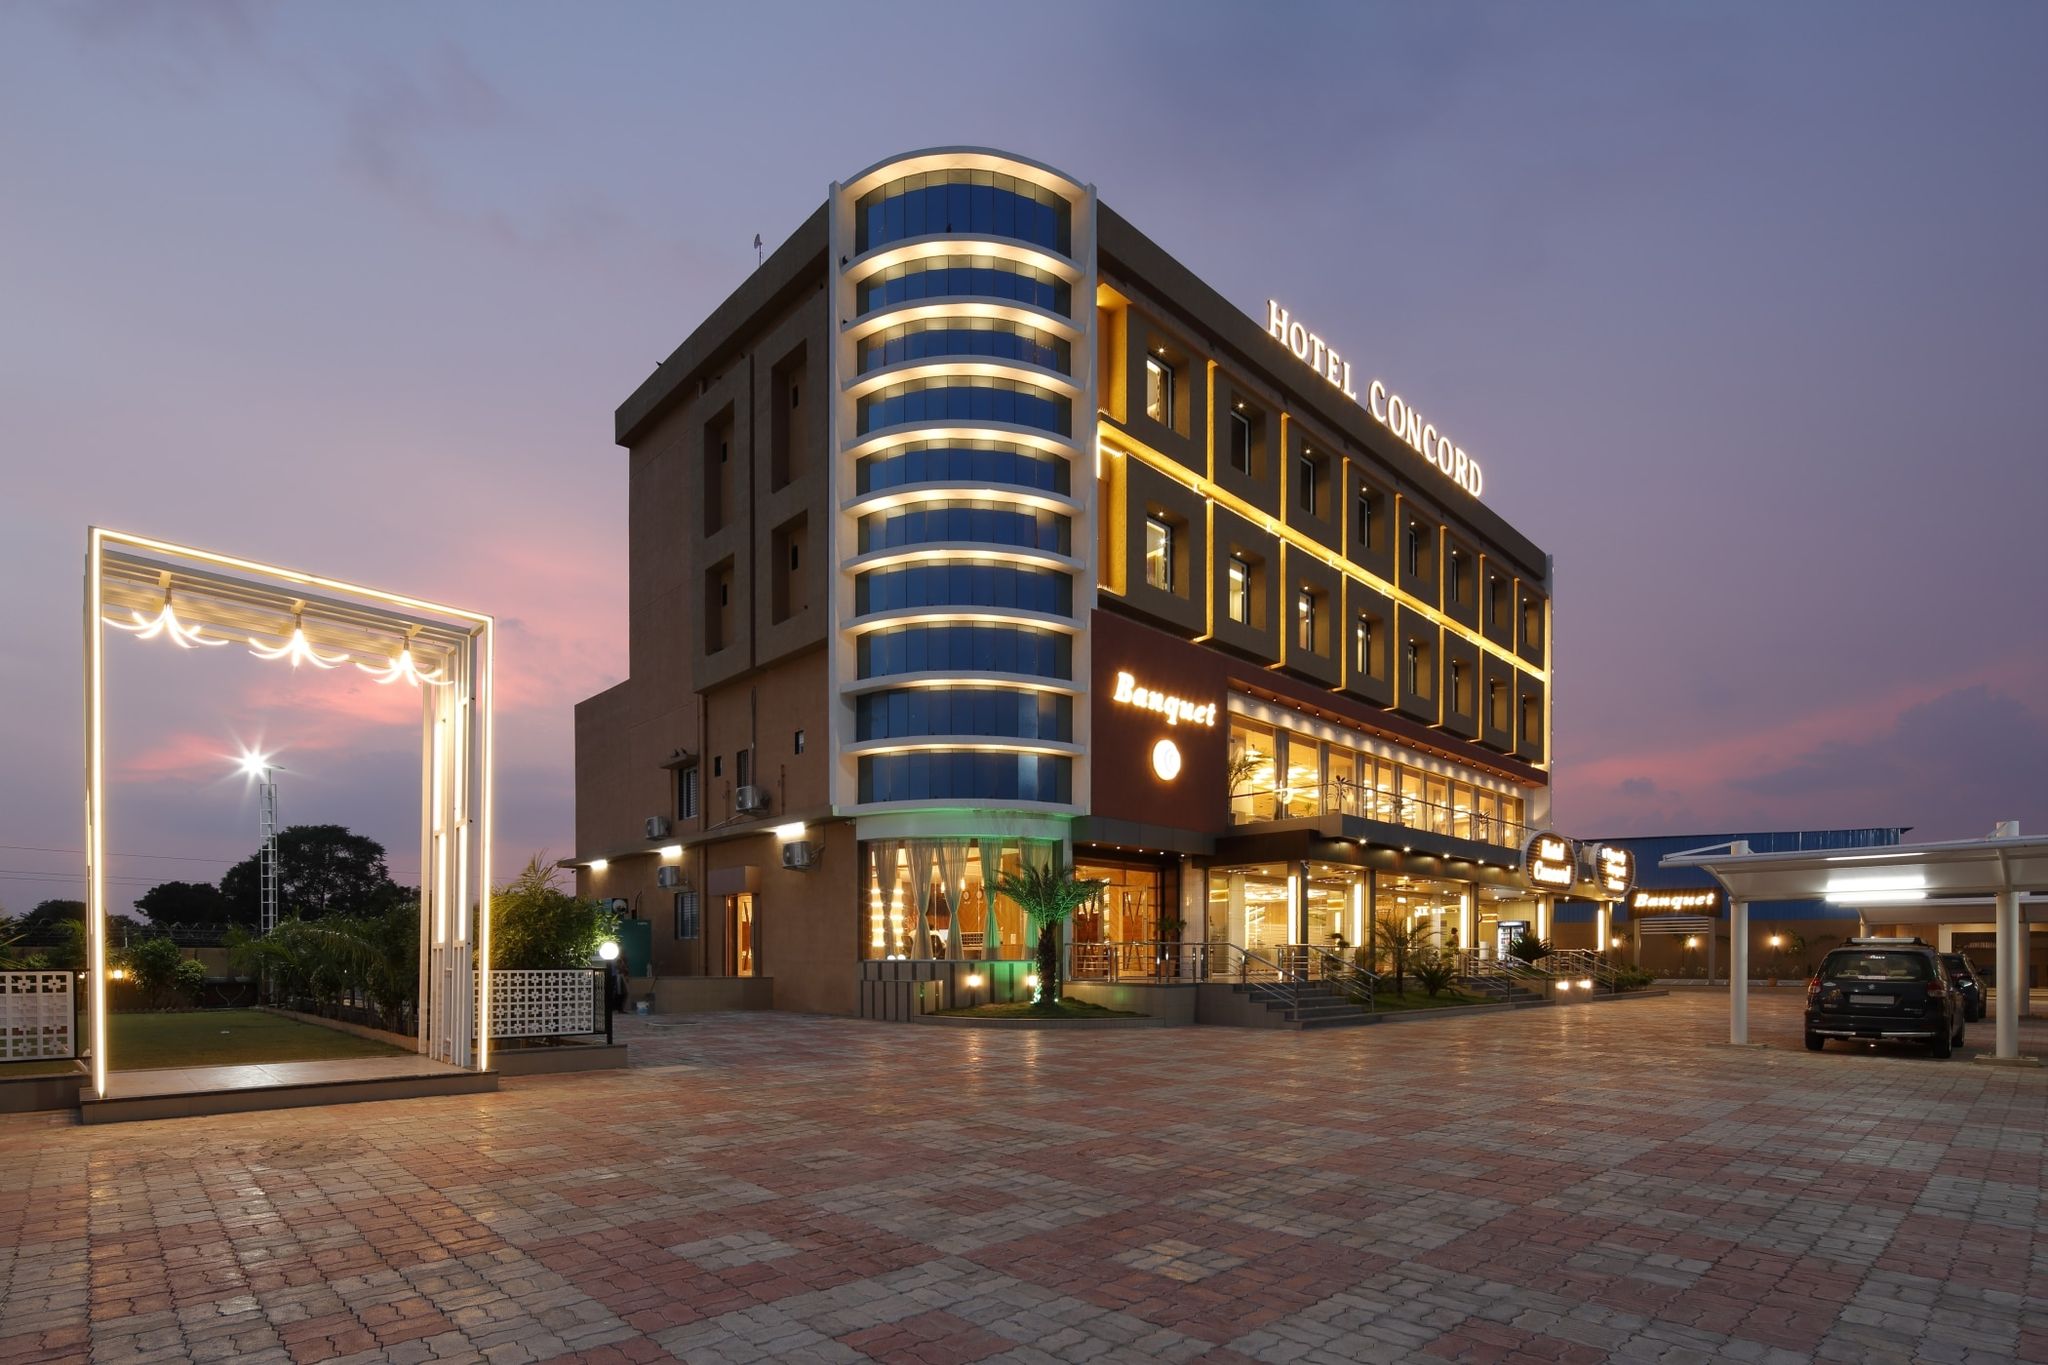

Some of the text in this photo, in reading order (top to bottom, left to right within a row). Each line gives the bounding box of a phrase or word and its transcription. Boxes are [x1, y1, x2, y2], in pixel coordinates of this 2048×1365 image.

[1268, 299, 1483, 497] HOTEL CONCORD
[1113, 671, 1216, 727] Banquet
[1634, 892, 1715, 910] Banquet
